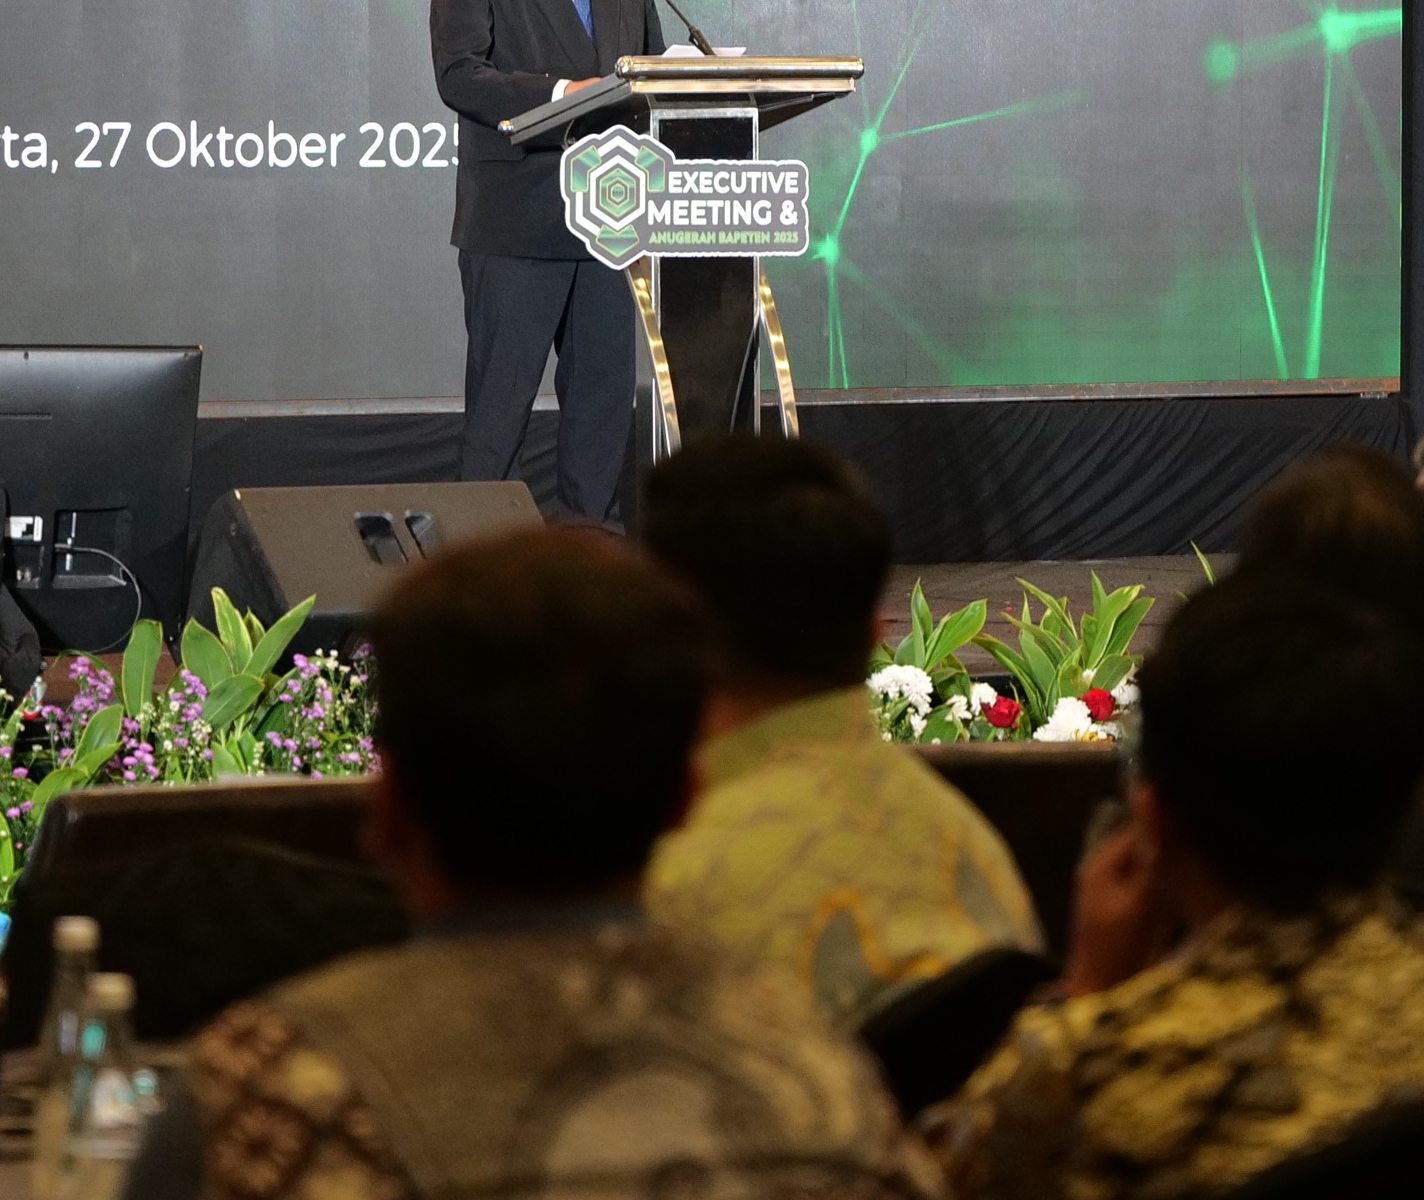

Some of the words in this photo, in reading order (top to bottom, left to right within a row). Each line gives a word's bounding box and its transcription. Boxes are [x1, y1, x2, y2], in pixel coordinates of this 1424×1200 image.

[74, 121, 132, 168] 27
[145, 119, 347, 168] Oktober
[358, 121, 460, 168] 202
[668, 171, 799, 194] EXECUTIVE
[647, 200, 772, 226] MEETING
[779, 200, 798, 226] &
[649, 231, 716, 244] ANUGERAH
[718, 231, 771, 244] BAPETEN
[773, 231, 798, 244] 2025
